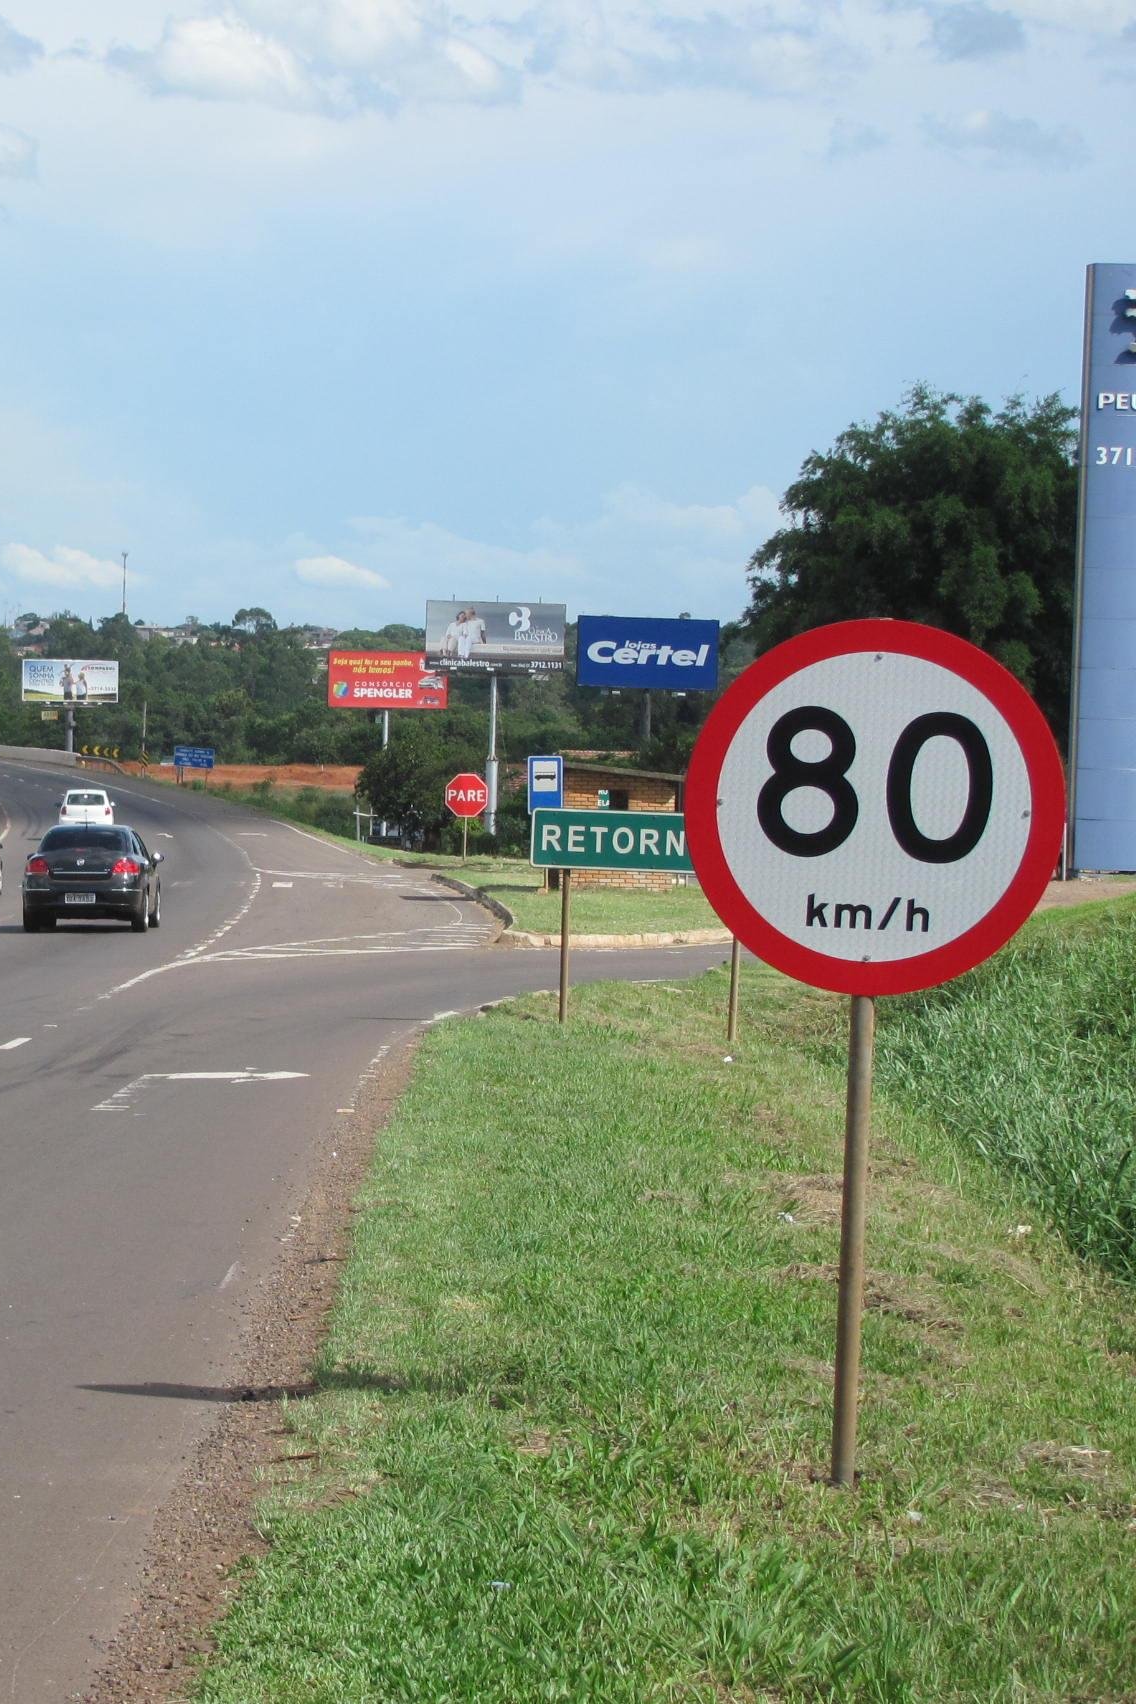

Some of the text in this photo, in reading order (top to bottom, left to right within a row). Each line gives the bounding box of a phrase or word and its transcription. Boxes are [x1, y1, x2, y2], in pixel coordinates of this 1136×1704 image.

[514, 630, 558, 643] BALESTRO
[624, 639, 657, 650] lojas
[587, 640, 710, 667] Certel
[333, 658, 347, 666] Seja
[349, 658, 363, 666] qual
[530, 661, 562, 669] 3712.1131
[352, 665, 367, 673] nós
[355, 680, 413, 688] CONSÓRCIO
[353, 687, 413, 699] SPENGLER
[757, 705, 993, 864] 80
[448, 789, 486, 802] PARE
[806, 893, 930, 932] km/h
